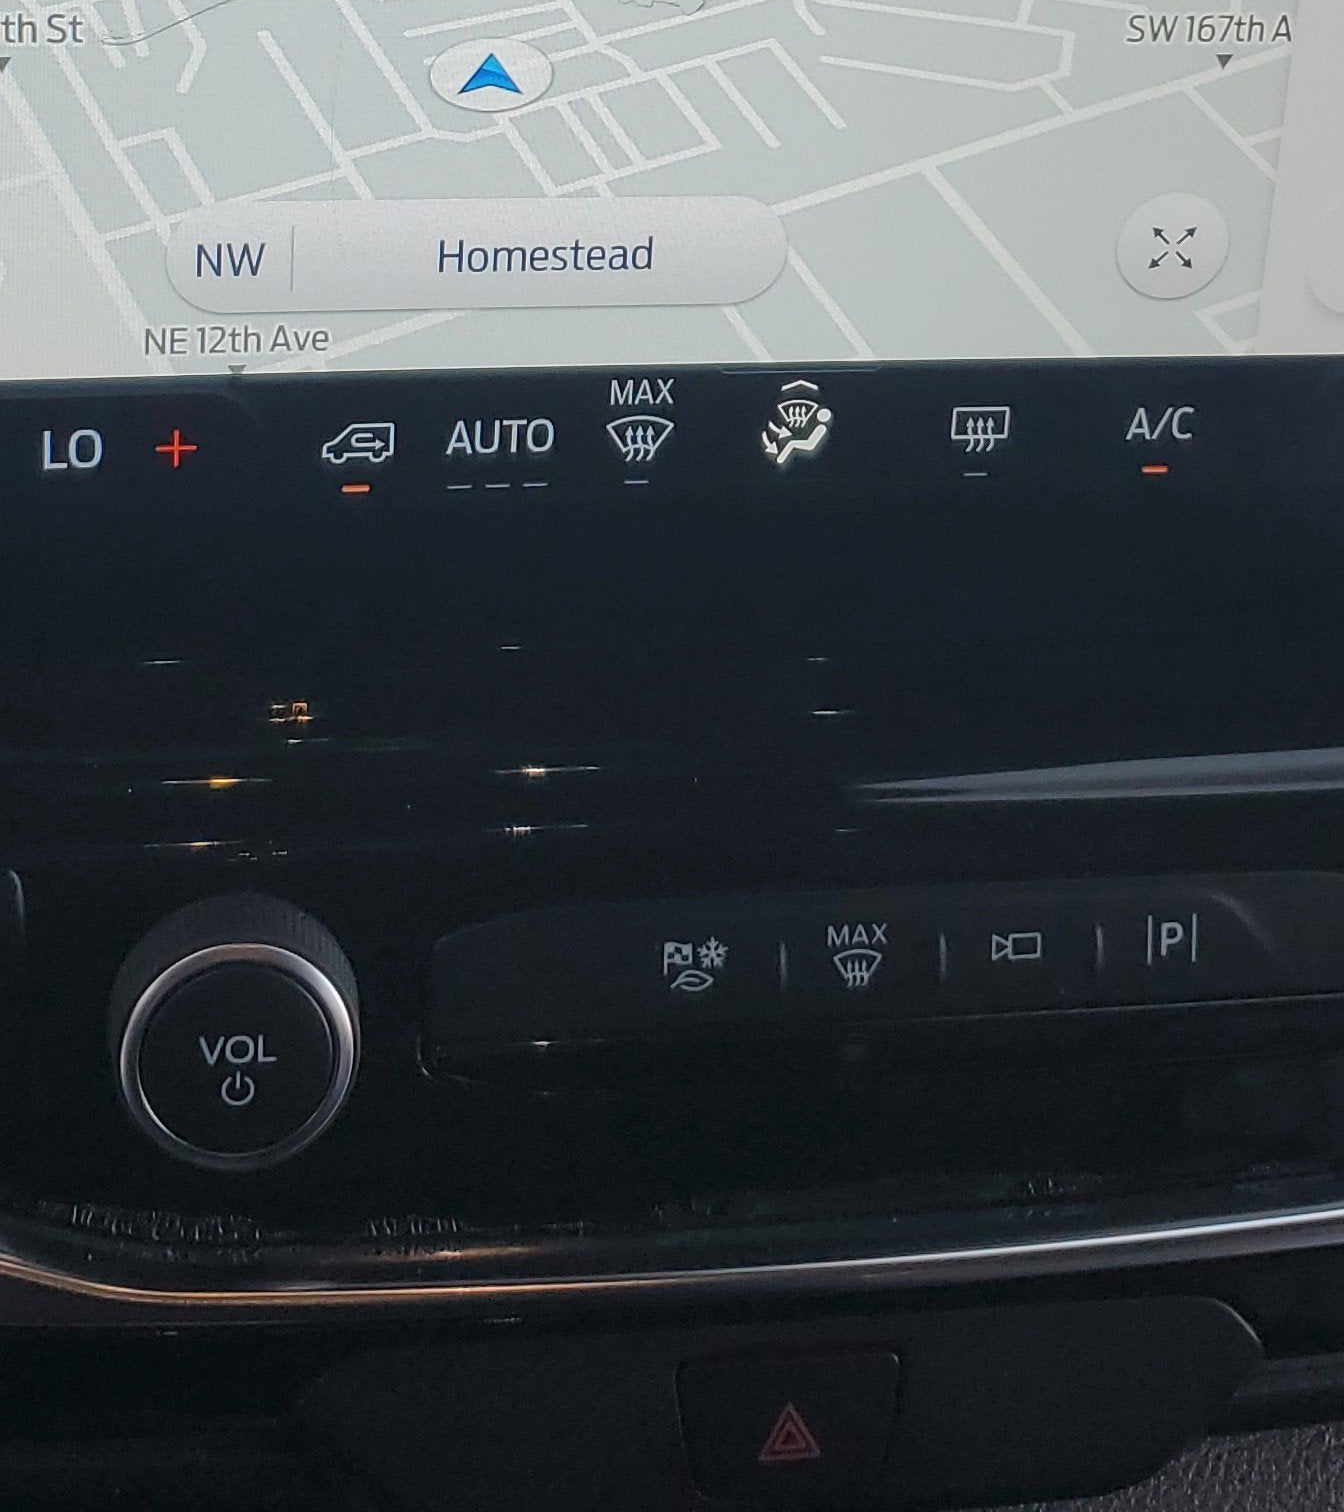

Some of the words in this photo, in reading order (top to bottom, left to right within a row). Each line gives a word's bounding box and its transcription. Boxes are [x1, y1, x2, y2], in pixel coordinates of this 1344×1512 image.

[46, 16, 84, 45] St
[1126, 14, 1177, 44] SW
[1185, 14, 1264, 45] 167th
[1271, 14, 1292, 44] A
[195, 243, 266, 278] NW
[437, 236, 654, 274] Homestead
[145, 327, 188, 355] NE
[197, 325, 261, 354] 12th
[270, 326, 330, 354] Ave
[609, 378, 675, 406] MAX
[445, 418, 555, 456] AUTO
[1125, 406, 1195, 441] A/C
[42, 429, 103, 470] LO
[827, 923, 889, 948] MAX
[199, 1034, 277, 1065] VOL
